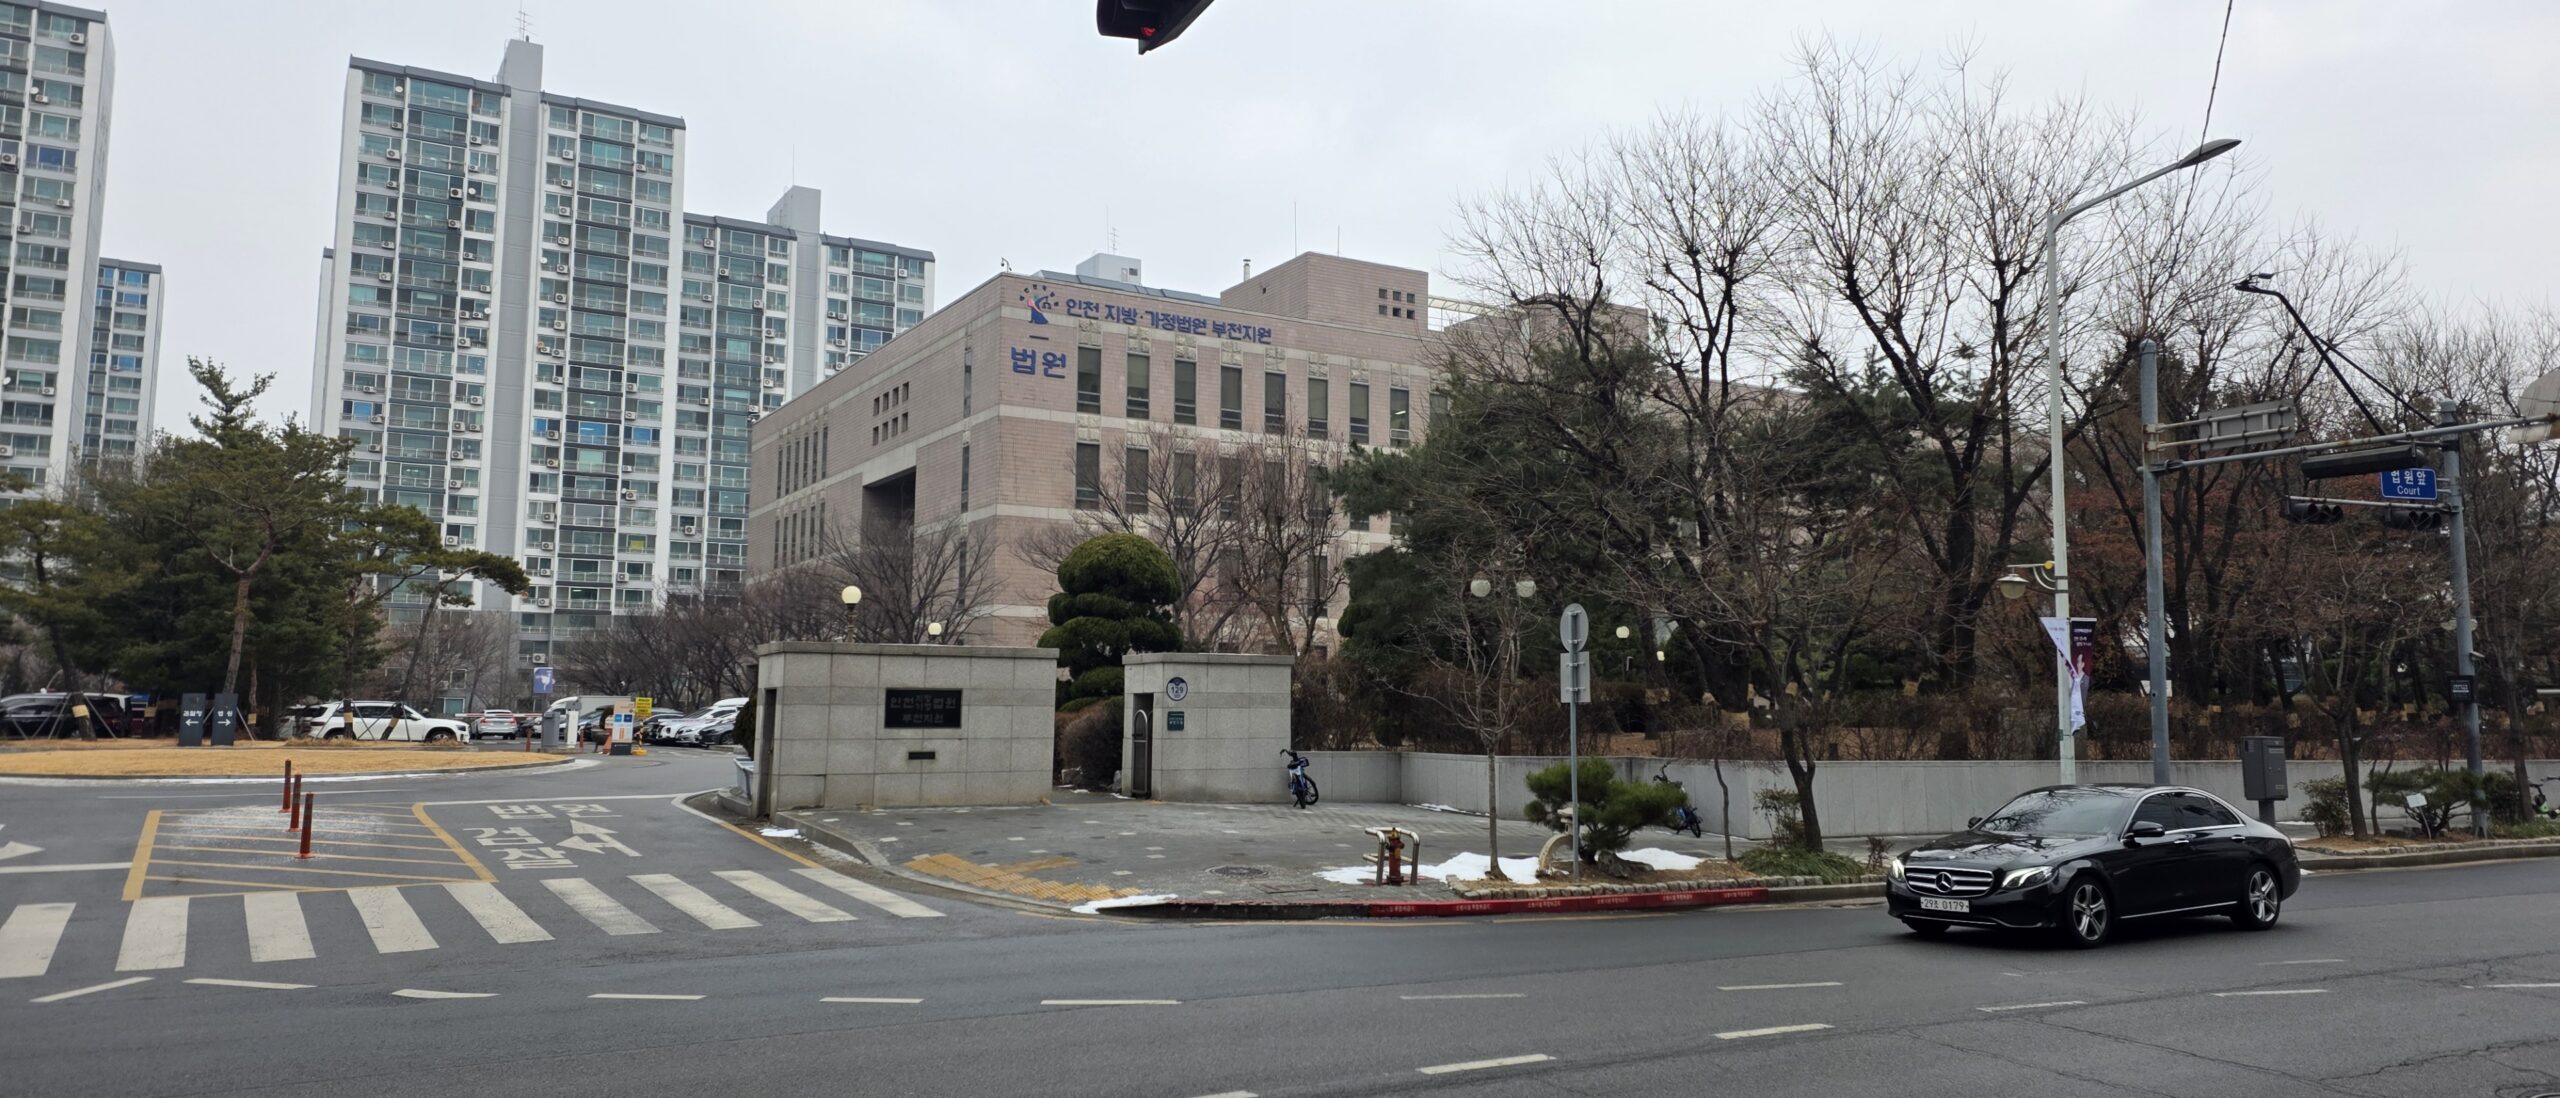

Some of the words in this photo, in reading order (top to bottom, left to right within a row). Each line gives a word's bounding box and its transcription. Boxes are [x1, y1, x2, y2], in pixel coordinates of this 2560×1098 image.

[1066, 298, 1099, 320] 인천
[1212, 319, 1271, 345] 부천지원
[1011, 346, 1067, 379] 법원
[2396, 485, 2421, 496] Court
[1942, 900, 1965, 911] 0179
